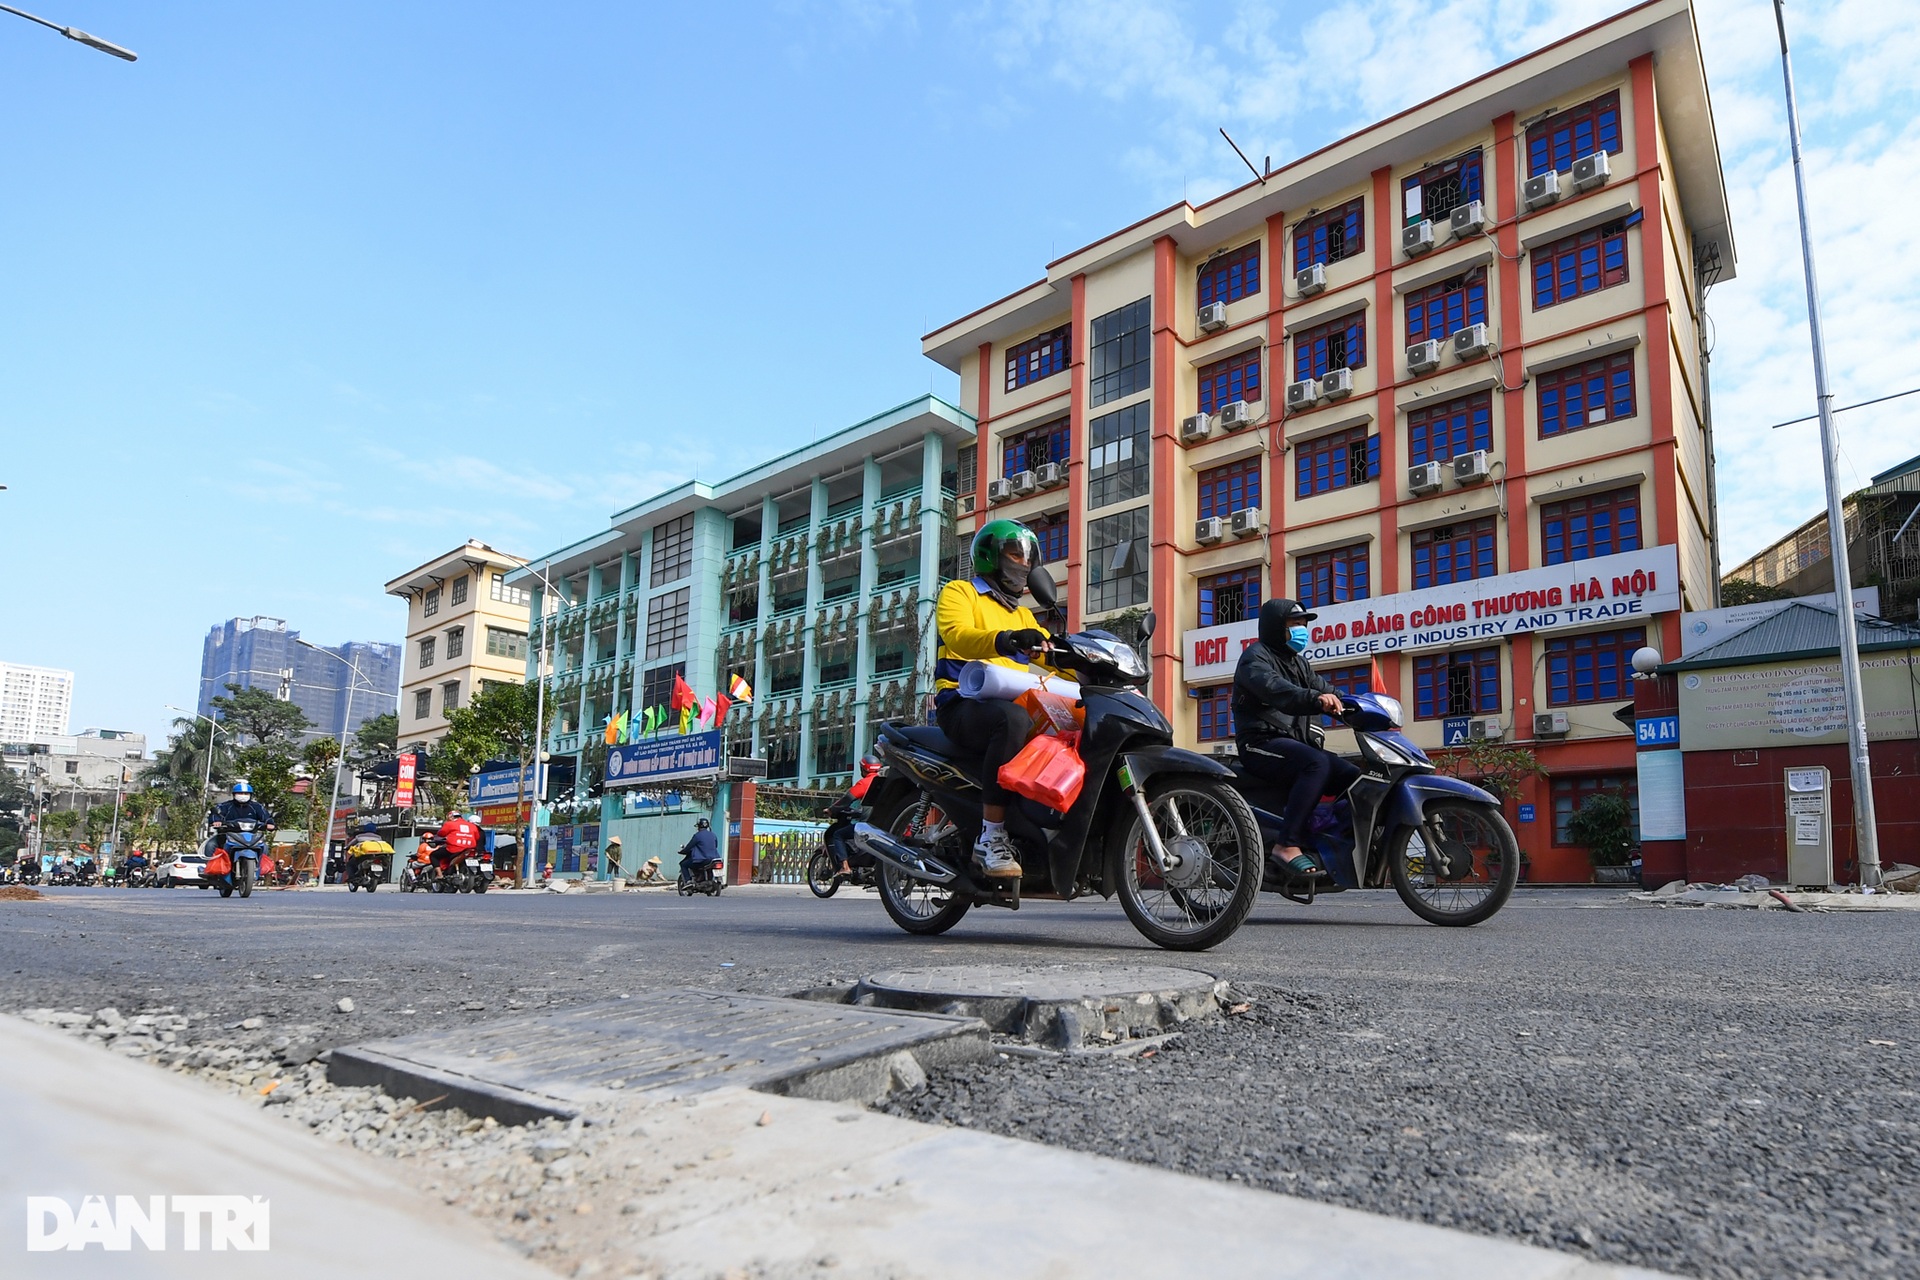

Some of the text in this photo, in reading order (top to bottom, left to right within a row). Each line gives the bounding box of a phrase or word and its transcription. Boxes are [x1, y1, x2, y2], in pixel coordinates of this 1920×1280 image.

[1195, 636, 1228, 666] HCIT
[1311, 623, 1347, 643] CAO
[1351, 611, 1404, 638] ĐẲNG
[1410, 603, 1466, 628] CÔNG
[1472, 587, 1562, 618] THƯƠNG
[1570, 577, 1604, 603] HÀ
[1612, 569, 1656, 596] NỘI
[1303, 600, 1642, 660] COLLEGE OF INDUSTRY AND TRADE
[1752, 671, 1772, 679] CAO
[1804, 664, 1832, 675] CÔNG
[1882, 656, 1896, 666] HÀ
[1447, 720, 1467, 728] NHÀ
[1639, 722, 1676, 741] 54 A1
[1449, 730, 1470, 744] A
